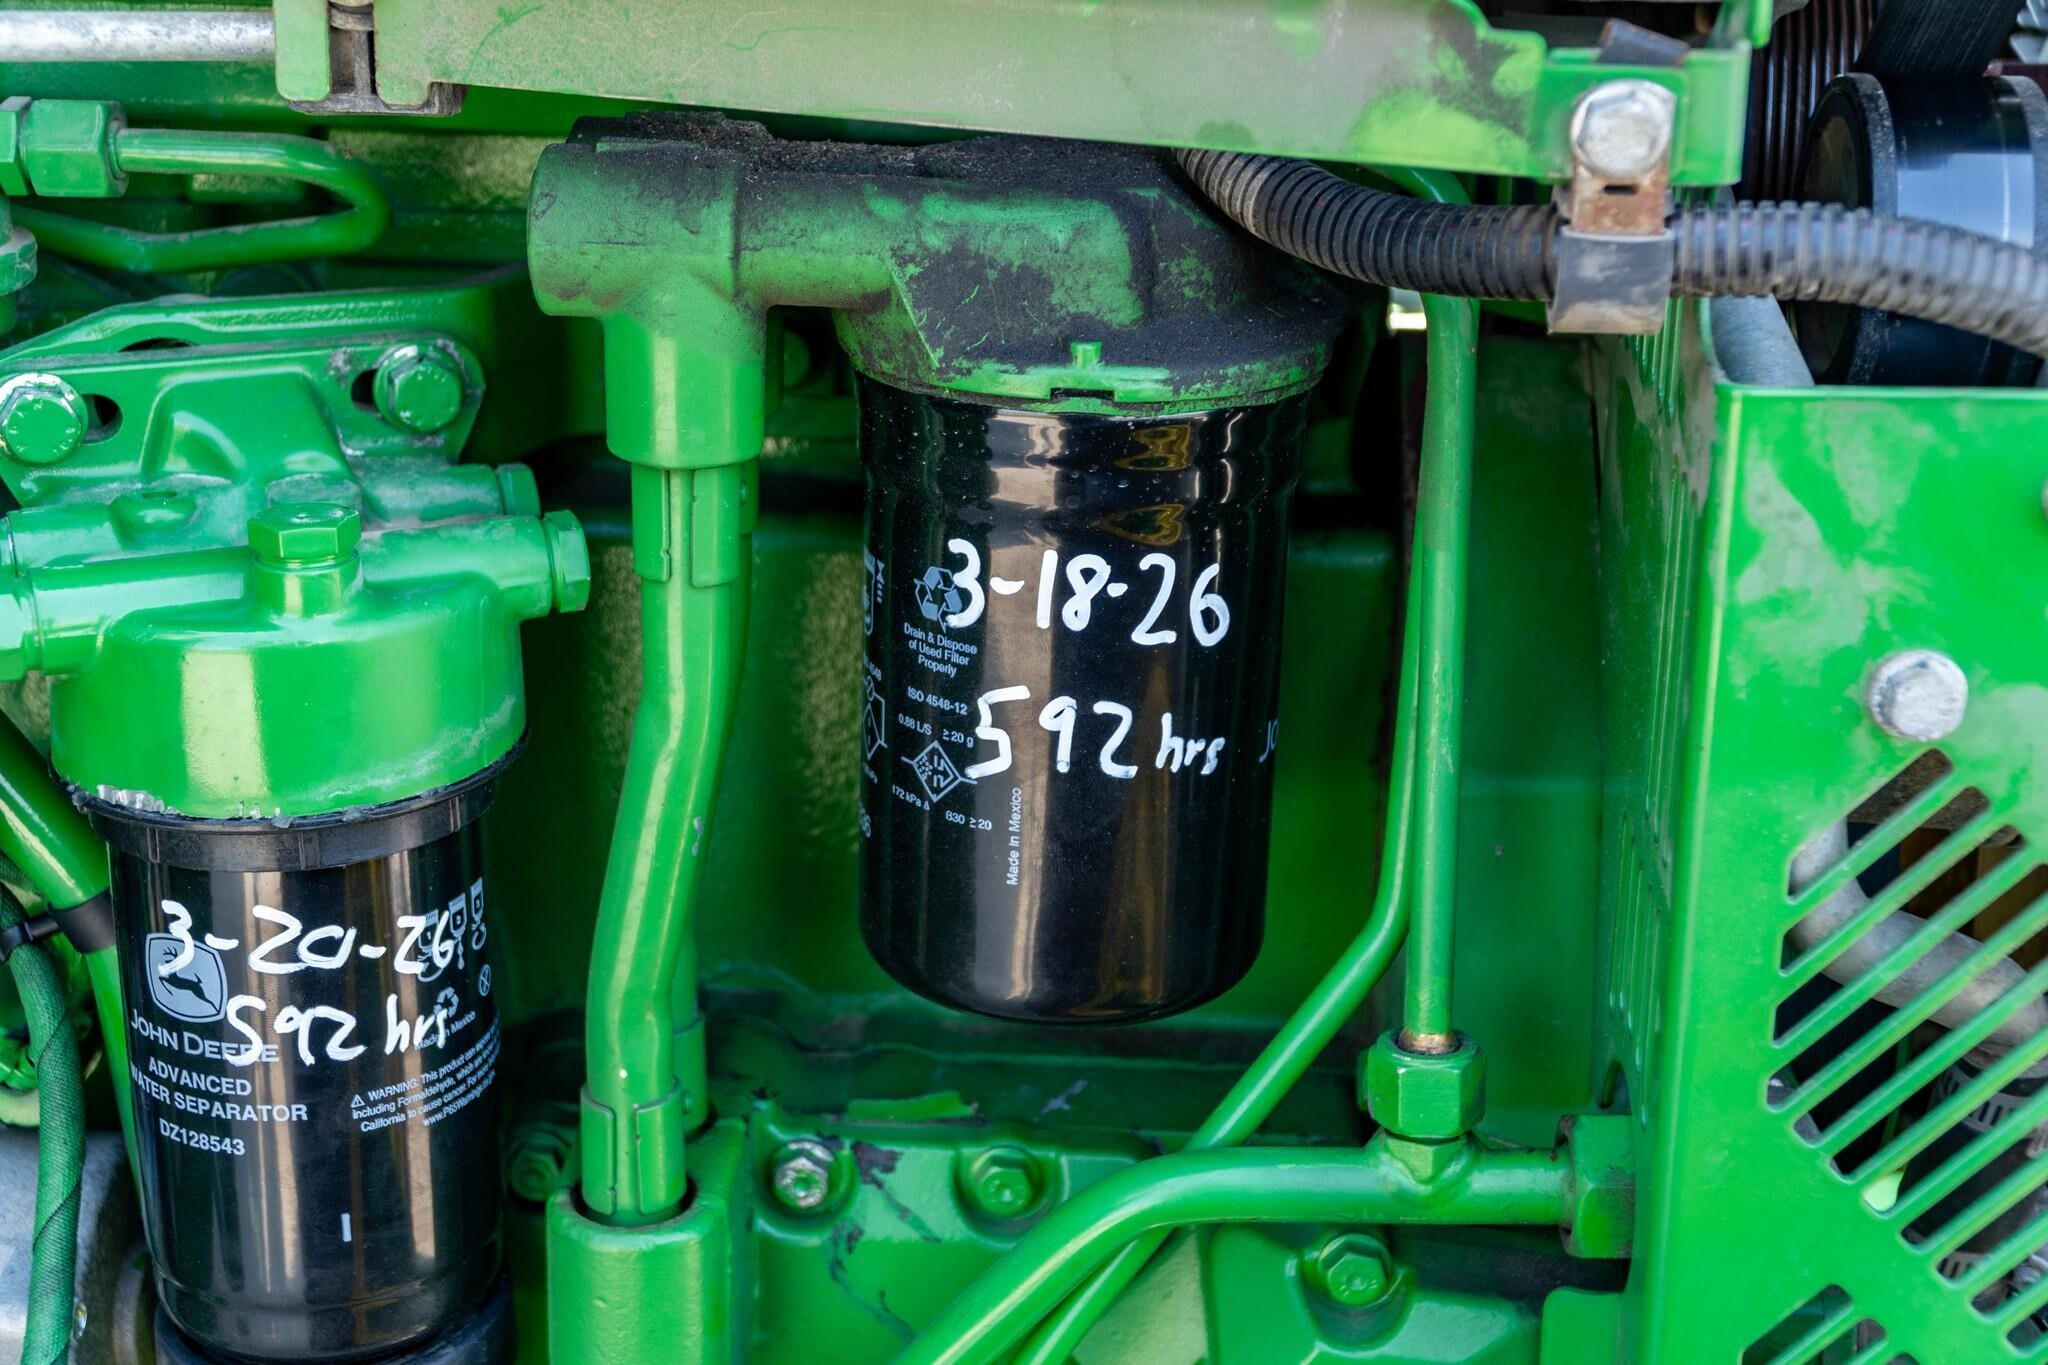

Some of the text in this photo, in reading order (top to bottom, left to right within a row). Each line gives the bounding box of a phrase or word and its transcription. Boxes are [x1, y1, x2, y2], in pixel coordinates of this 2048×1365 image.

[948, 538, 1230, 646] 3-18-26
[903, 622, 978, 655] Drain & Dispose
[908, 639, 970, 666] of Used Filter
[918, 654, 957, 678] Properly
[907, 686, 968, 715] ISO 4548-12
[917, 720, 933, 736] L/S
[966, 737, 974, 749] g
[966, 685, 1226, 778] 592 hrs
[891, 784, 905, 799] 172
[905, 792, 922, 807] kPa
[1006, 786, 1022, 886] Made in Mexico
[158, 899, 454, 976] 3-20-26
[131, 1008, 179, 1051] JOHN
[225, 994, 367, 1067] 592
[450, 1010, 476, 1034] Mexico
[130, 1061, 308, 1122] WATER SEPARATOR
[149, 1055, 252, 1097] ADVANCED
[368, 1078, 420, 1101] WARNING:
[420, 1071, 438, 1084] This
[439, 1054, 465, 1078] product
[397, 1077, 456, 1108] Formaldehyde,
[361, 1113, 406, 1132] California
[407, 1109, 417, 1119] to
[418, 1098, 443, 1114] cause
[443, 1083, 468, 1103] cancer.
[159, 1117, 246, 1156] DZ128543
